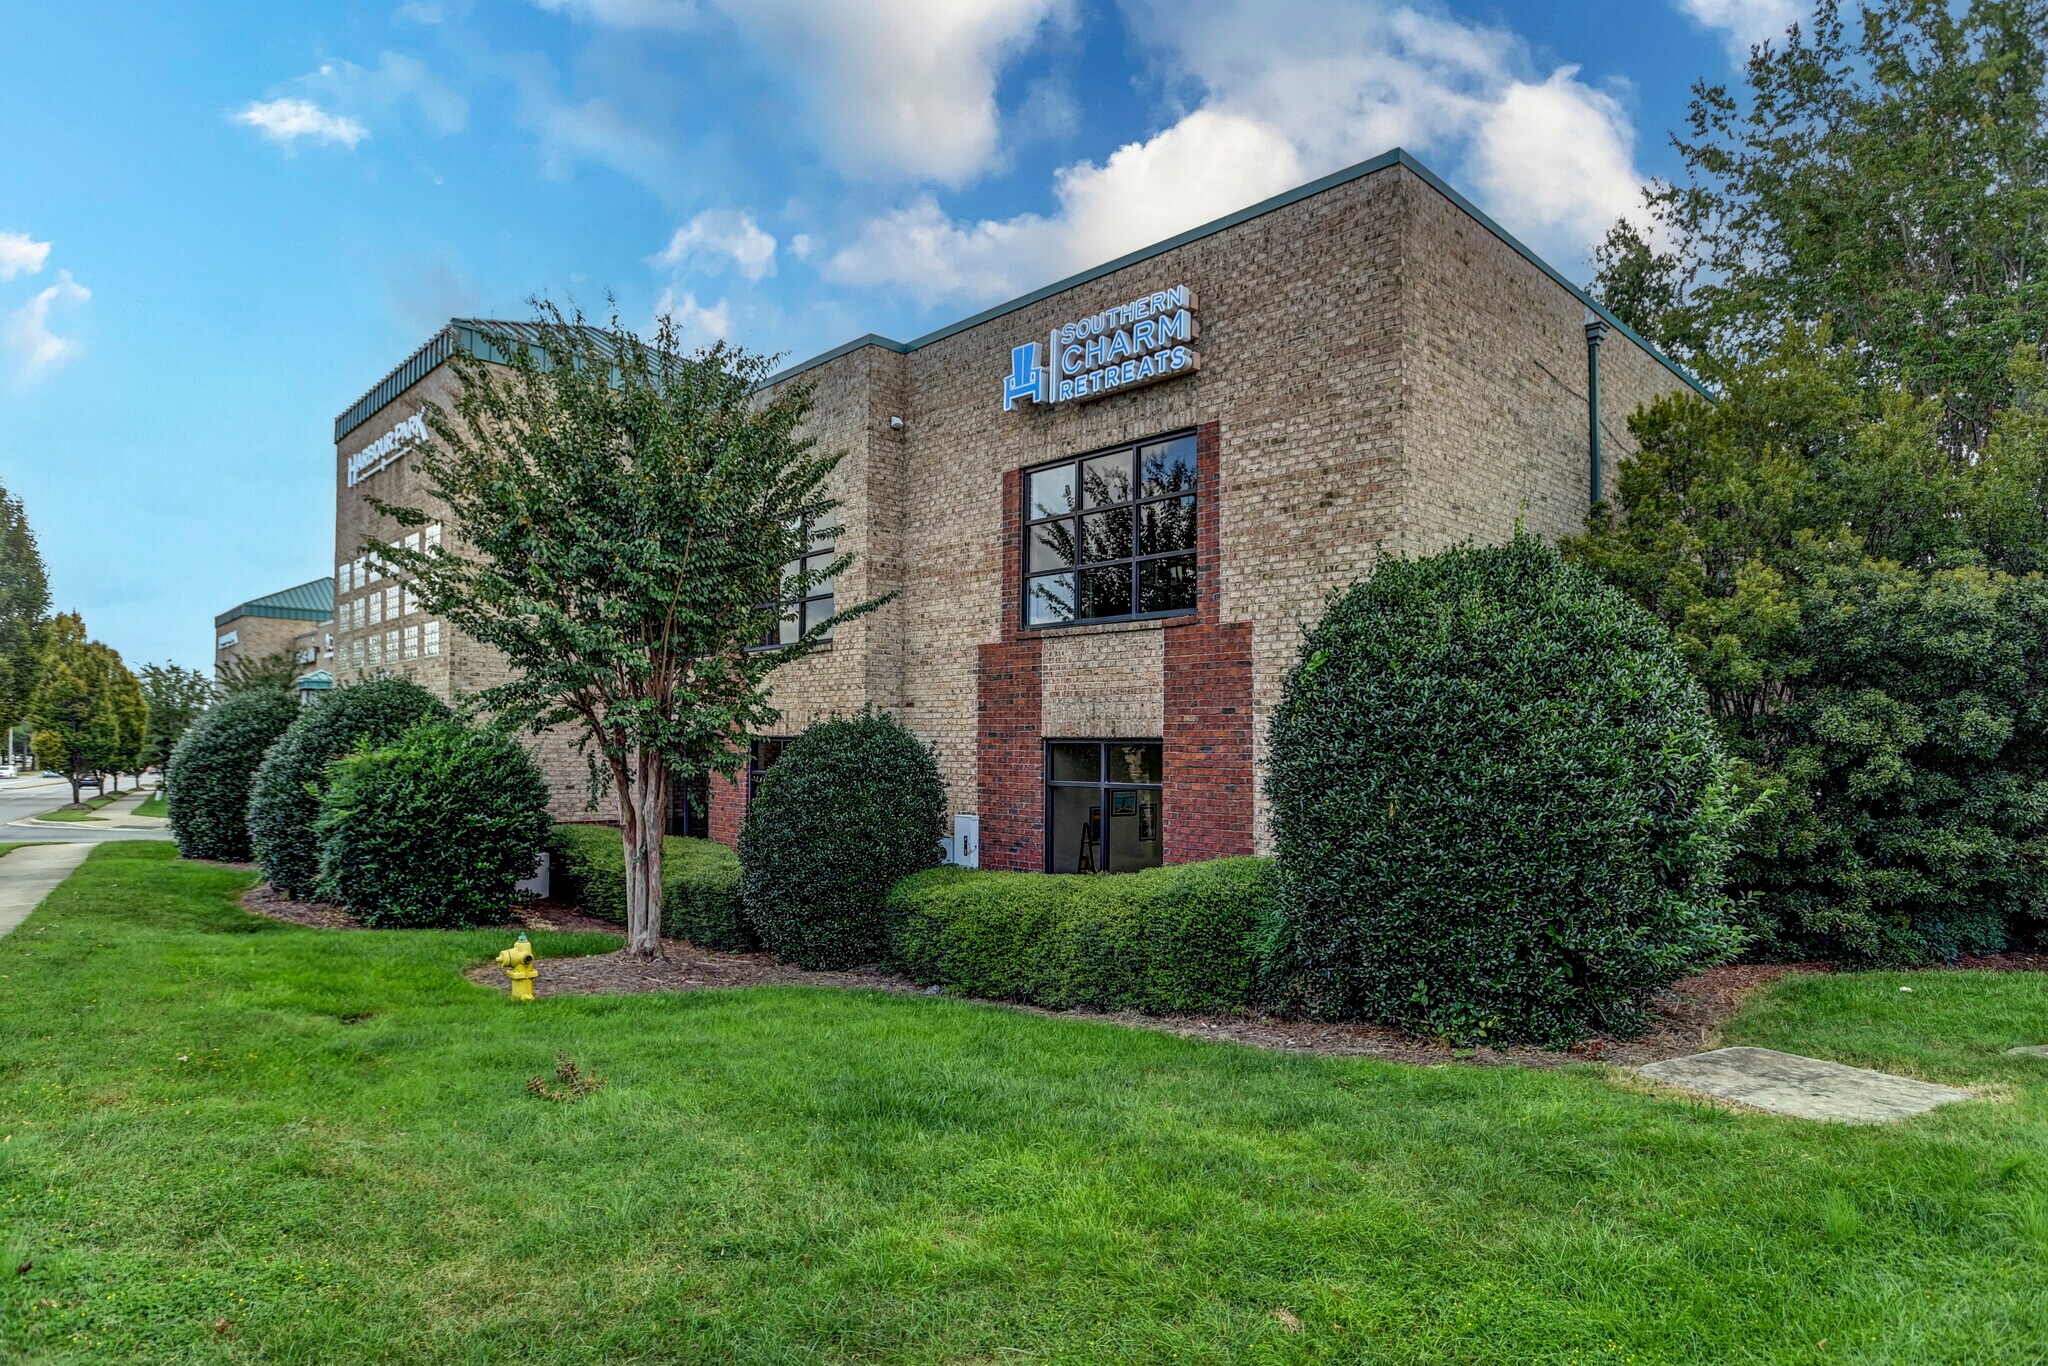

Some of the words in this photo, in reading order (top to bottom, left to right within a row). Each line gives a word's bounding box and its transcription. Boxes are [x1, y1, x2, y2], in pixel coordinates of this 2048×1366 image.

[1061, 284, 1187, 344] SOUTHERN
[1062, 309, 1189, 374] CHARM
[1059, 345, 1190, 401] RETREATS
